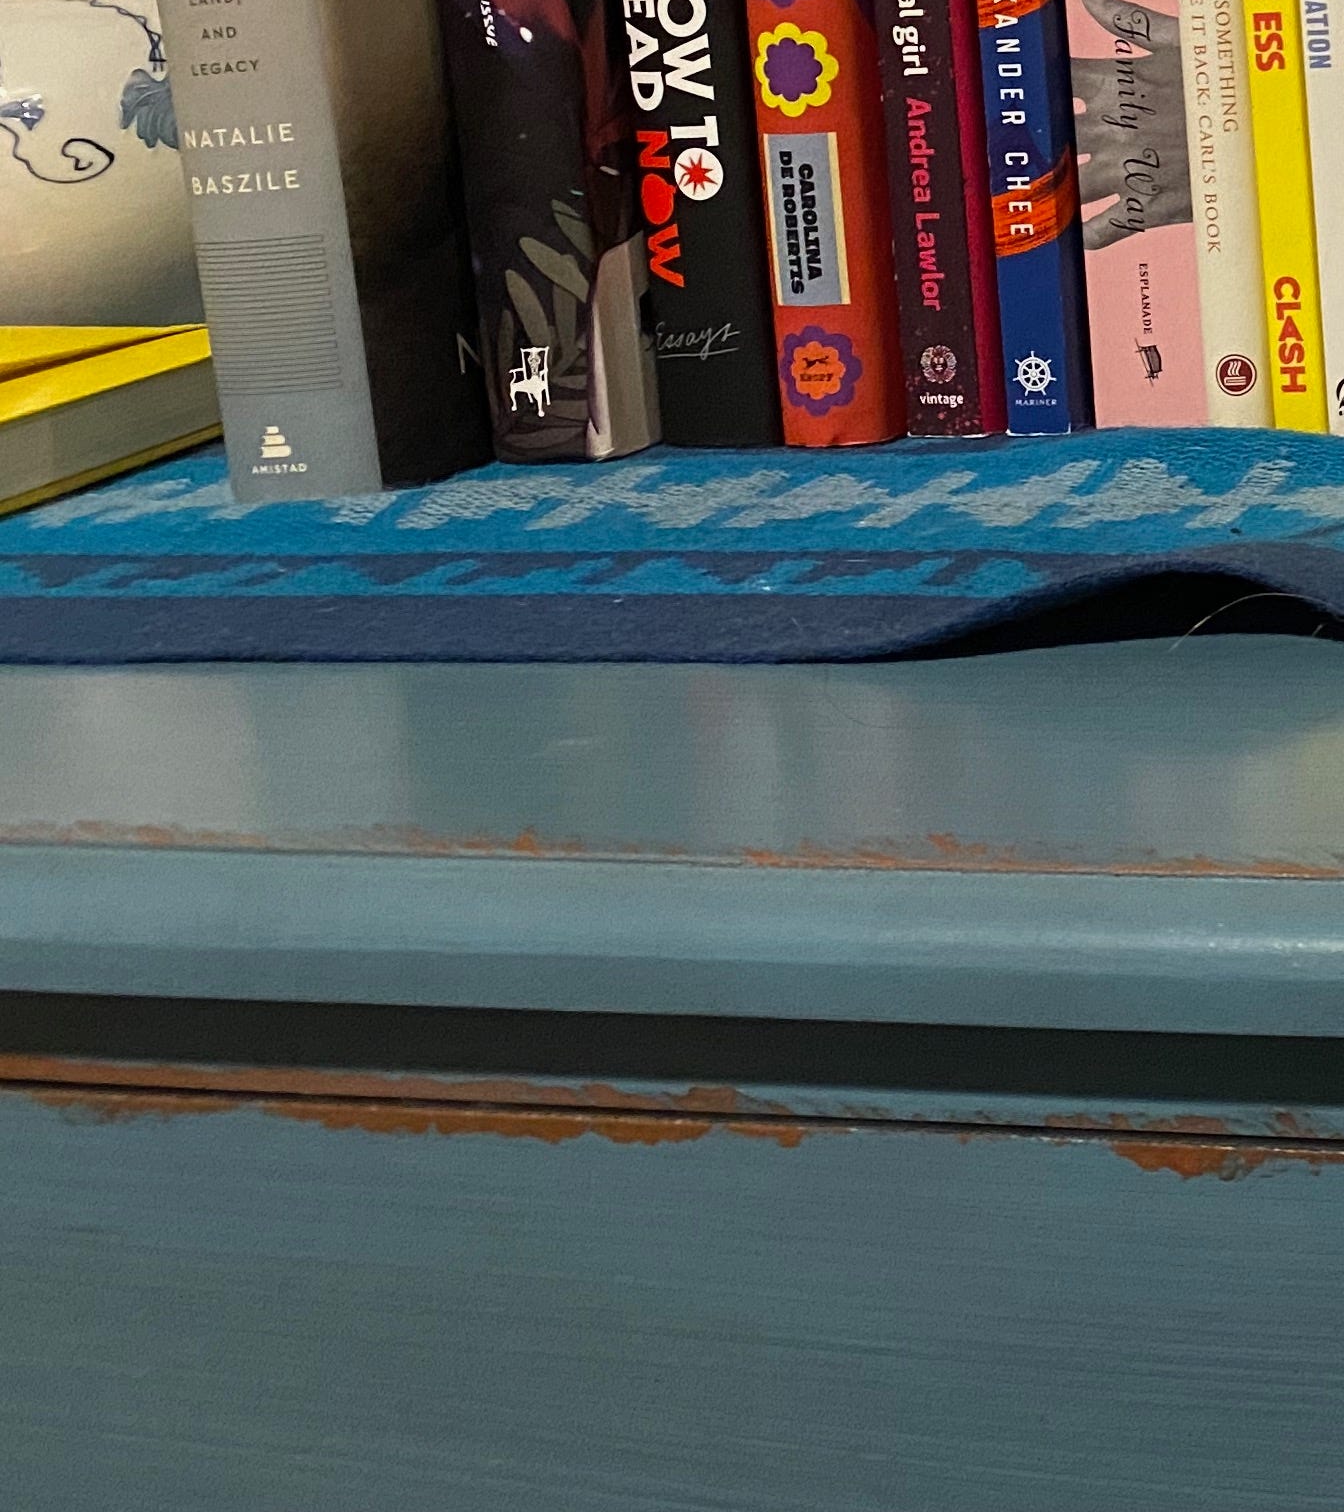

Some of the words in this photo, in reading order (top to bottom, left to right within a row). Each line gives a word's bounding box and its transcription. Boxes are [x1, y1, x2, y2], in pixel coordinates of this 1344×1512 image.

[201, 25, 237, 41] AND
[892, 28, 928, 76] girl
[1253, 11, 1286, 72] ESS
[190, 58, 259, 77] LEGACY
[1102, 9, 1156, 130] Family
[185, 123, 295, 149] NATALIE
[778, 150, 793, 179] DE
[905, 97, 934, 204] Andrea
[191, 169, 300, 196] BASZILE
[636, 130, 686, 288] NOW
[1004, 151, 1034, 236] CHEE
[1109, 147, 1161, 233] Way
[780, 185, 805, 295] ROBERTIS
[797, 163, 823, 282] CAROLINA
[914, 212, 947, 312] Lawlor
[1138, 263, 1153, 336] ESPLANADE
[920, 390, 965, 407] vintage
[251, 461, 308, 475] AMISTAD
